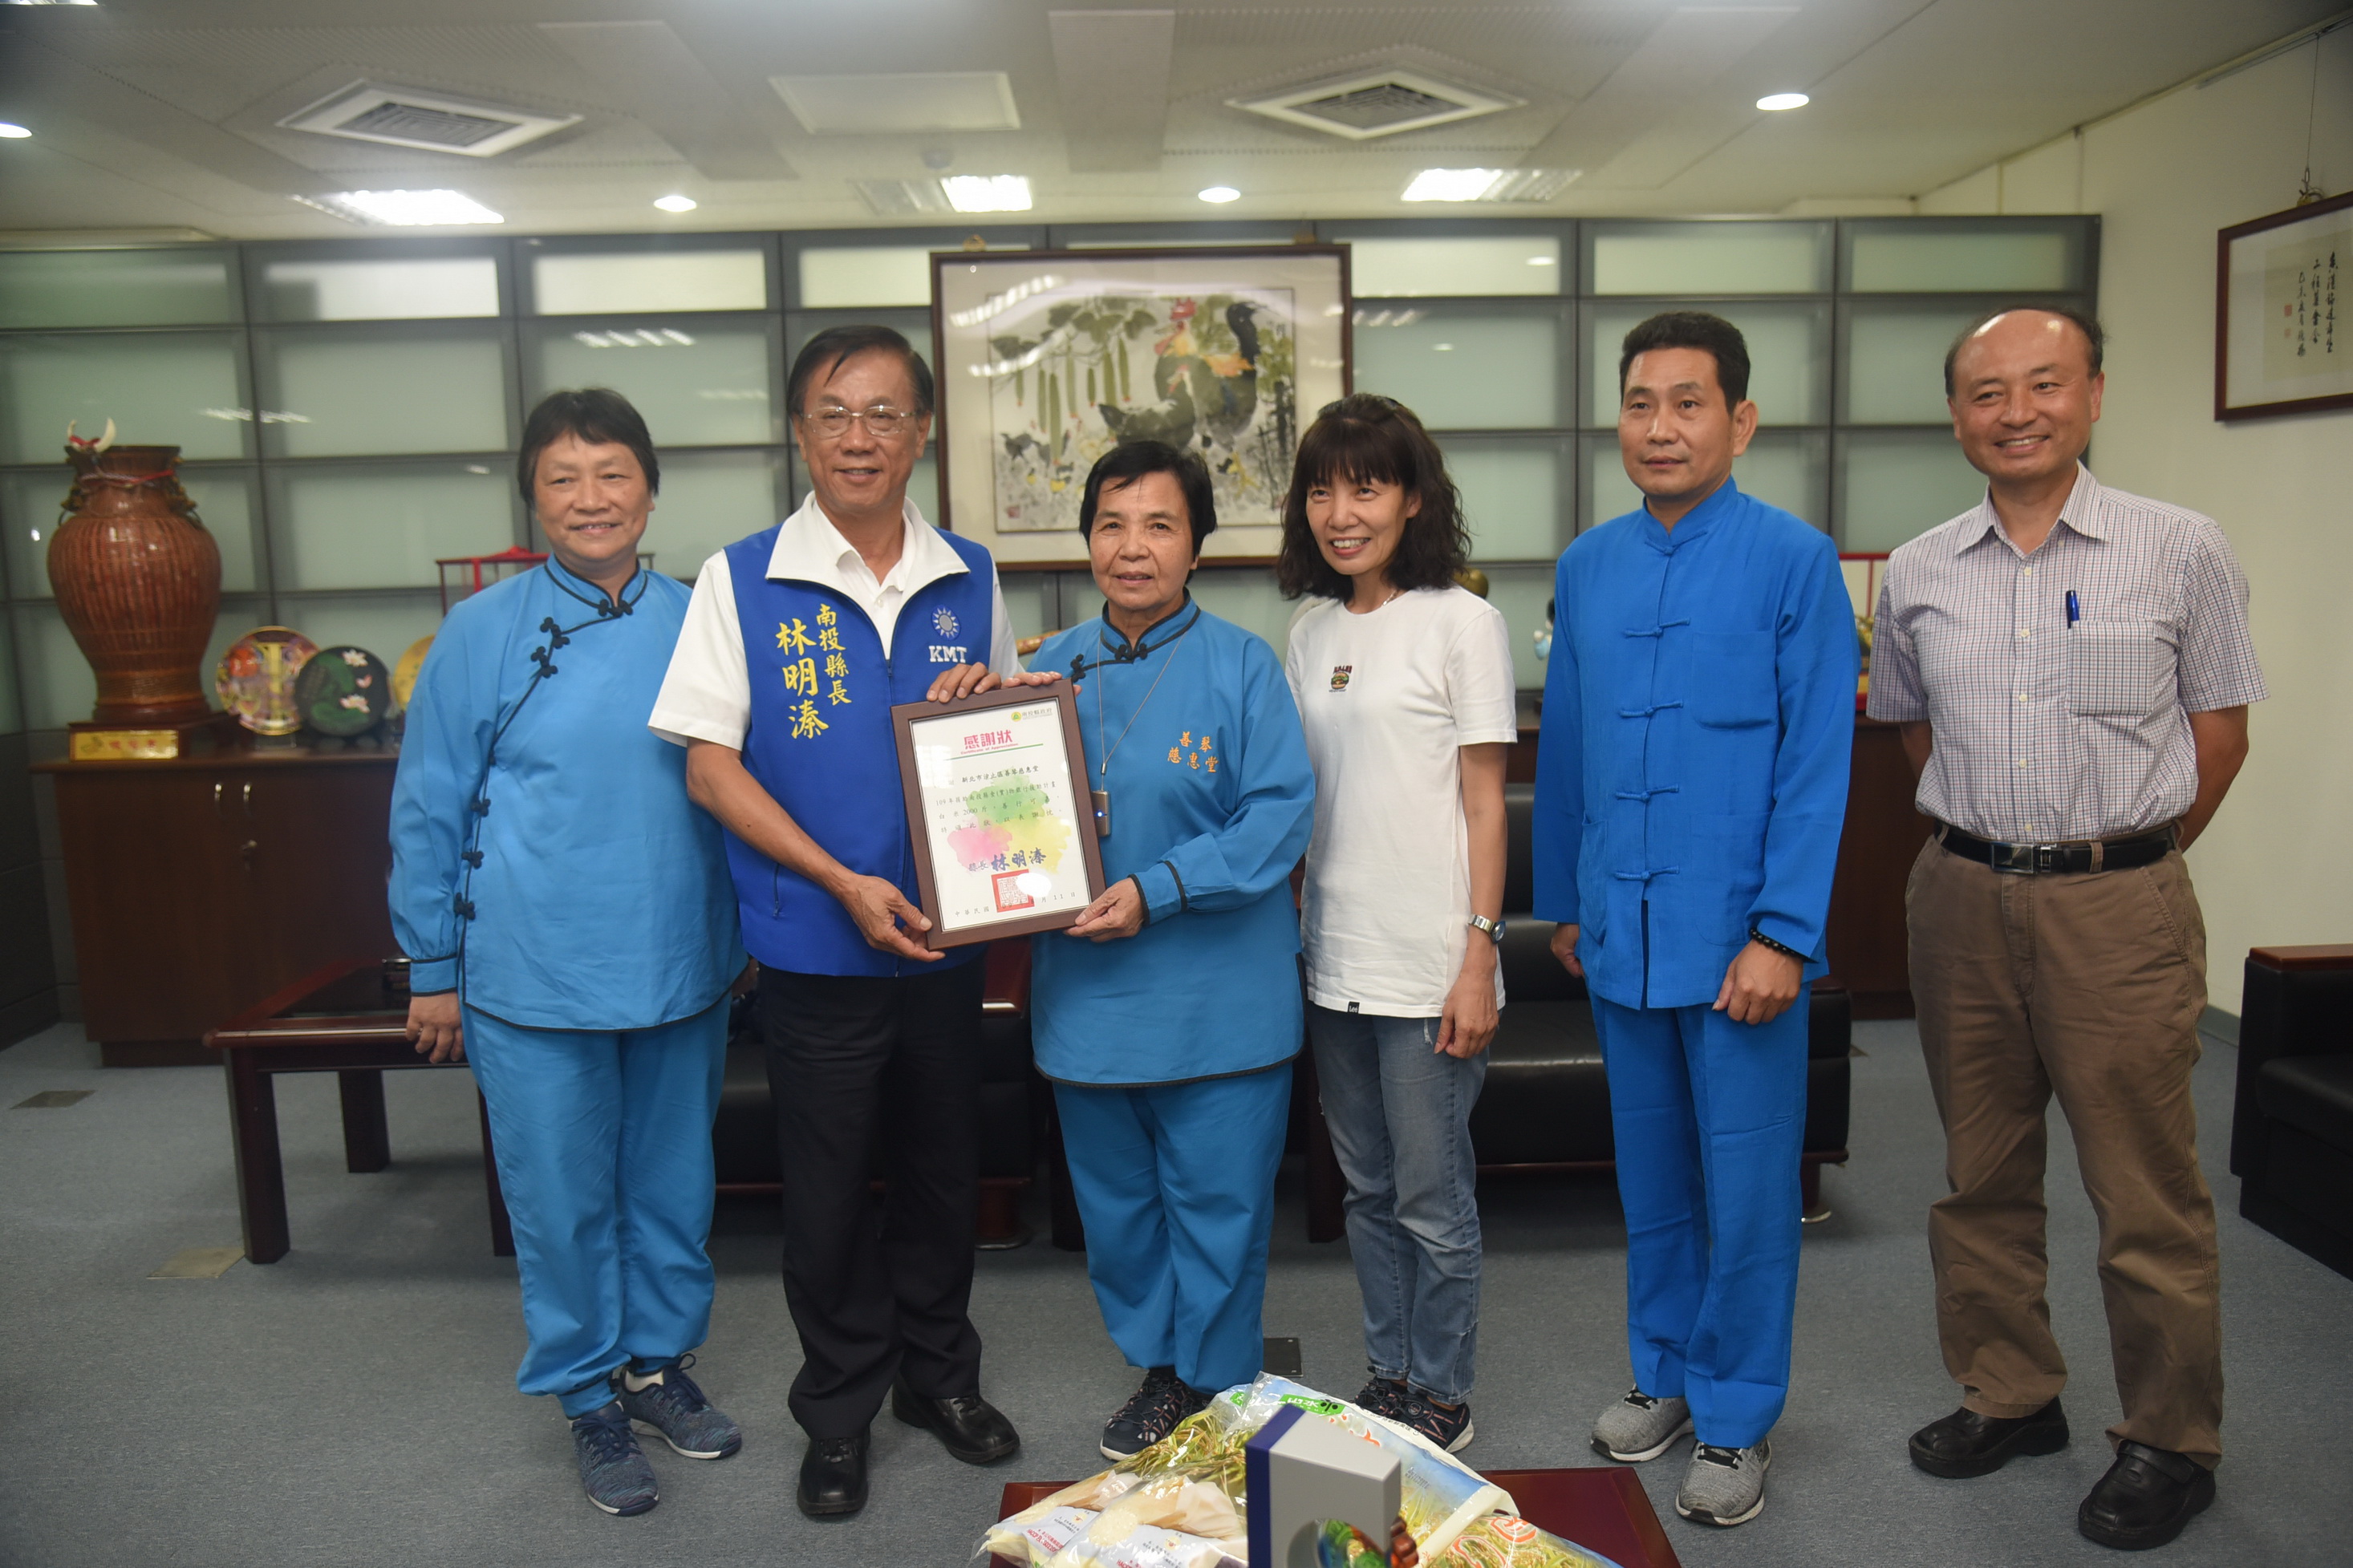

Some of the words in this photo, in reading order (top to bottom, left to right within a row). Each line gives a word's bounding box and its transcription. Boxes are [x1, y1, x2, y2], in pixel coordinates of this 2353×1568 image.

[816, 603, 852, 706] 南投縣長
[928, 645, 968, 663] KMT
[775, 618, 830, 739] 林明溱
[960, 747, 984, 756] Certificate
[991, 742, 1019, 752] Appreciation
[964, 729, 1013, 750] 感謝狀
[1179, 731, 1212, 752] 善琴
[1167, 746, 1219, 773] 慈惠堂
[991, 847, 1047, 872] 林明溱
